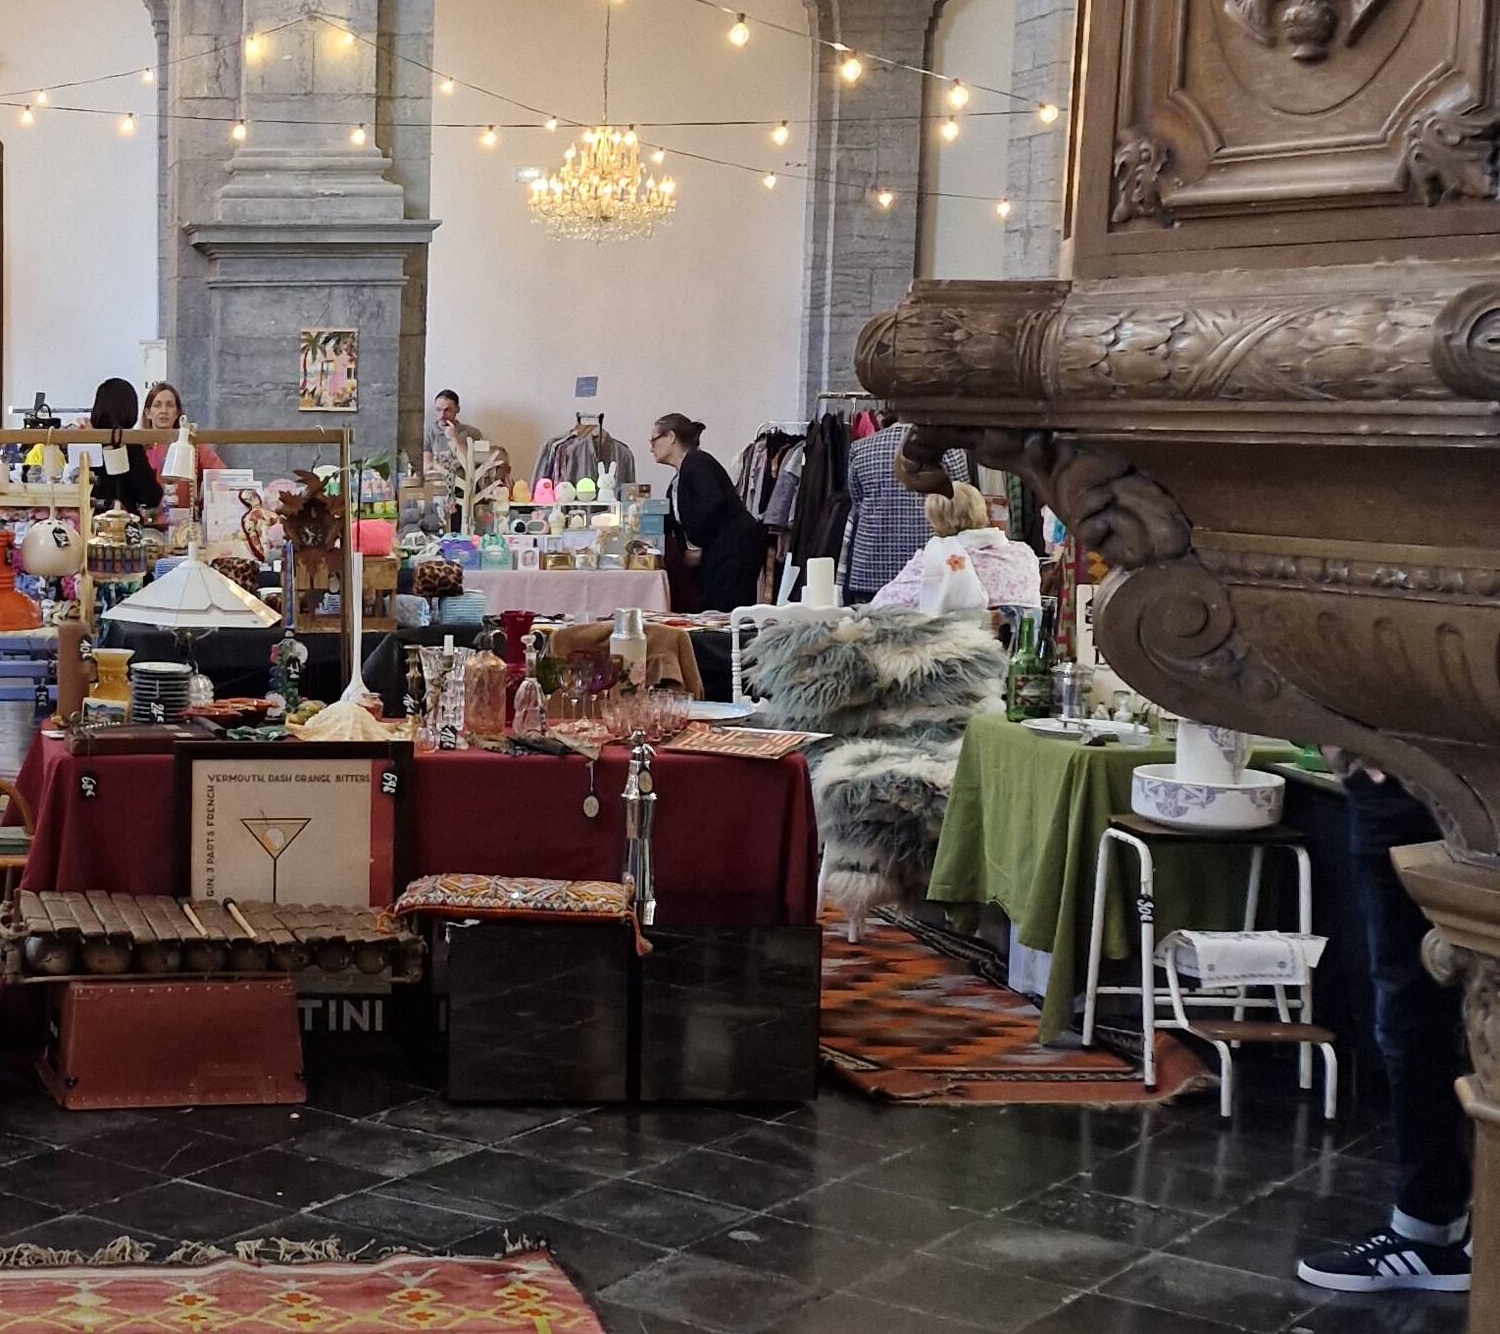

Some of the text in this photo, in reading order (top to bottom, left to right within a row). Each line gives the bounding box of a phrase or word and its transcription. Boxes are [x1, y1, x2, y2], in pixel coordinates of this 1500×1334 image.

[294, 774, 331, 783] ORANGE
[335, 774, 371, 782] BITTERS
[206, 785, 215, 826] FRENCH
[206, 830, 215, 865] PARTS
